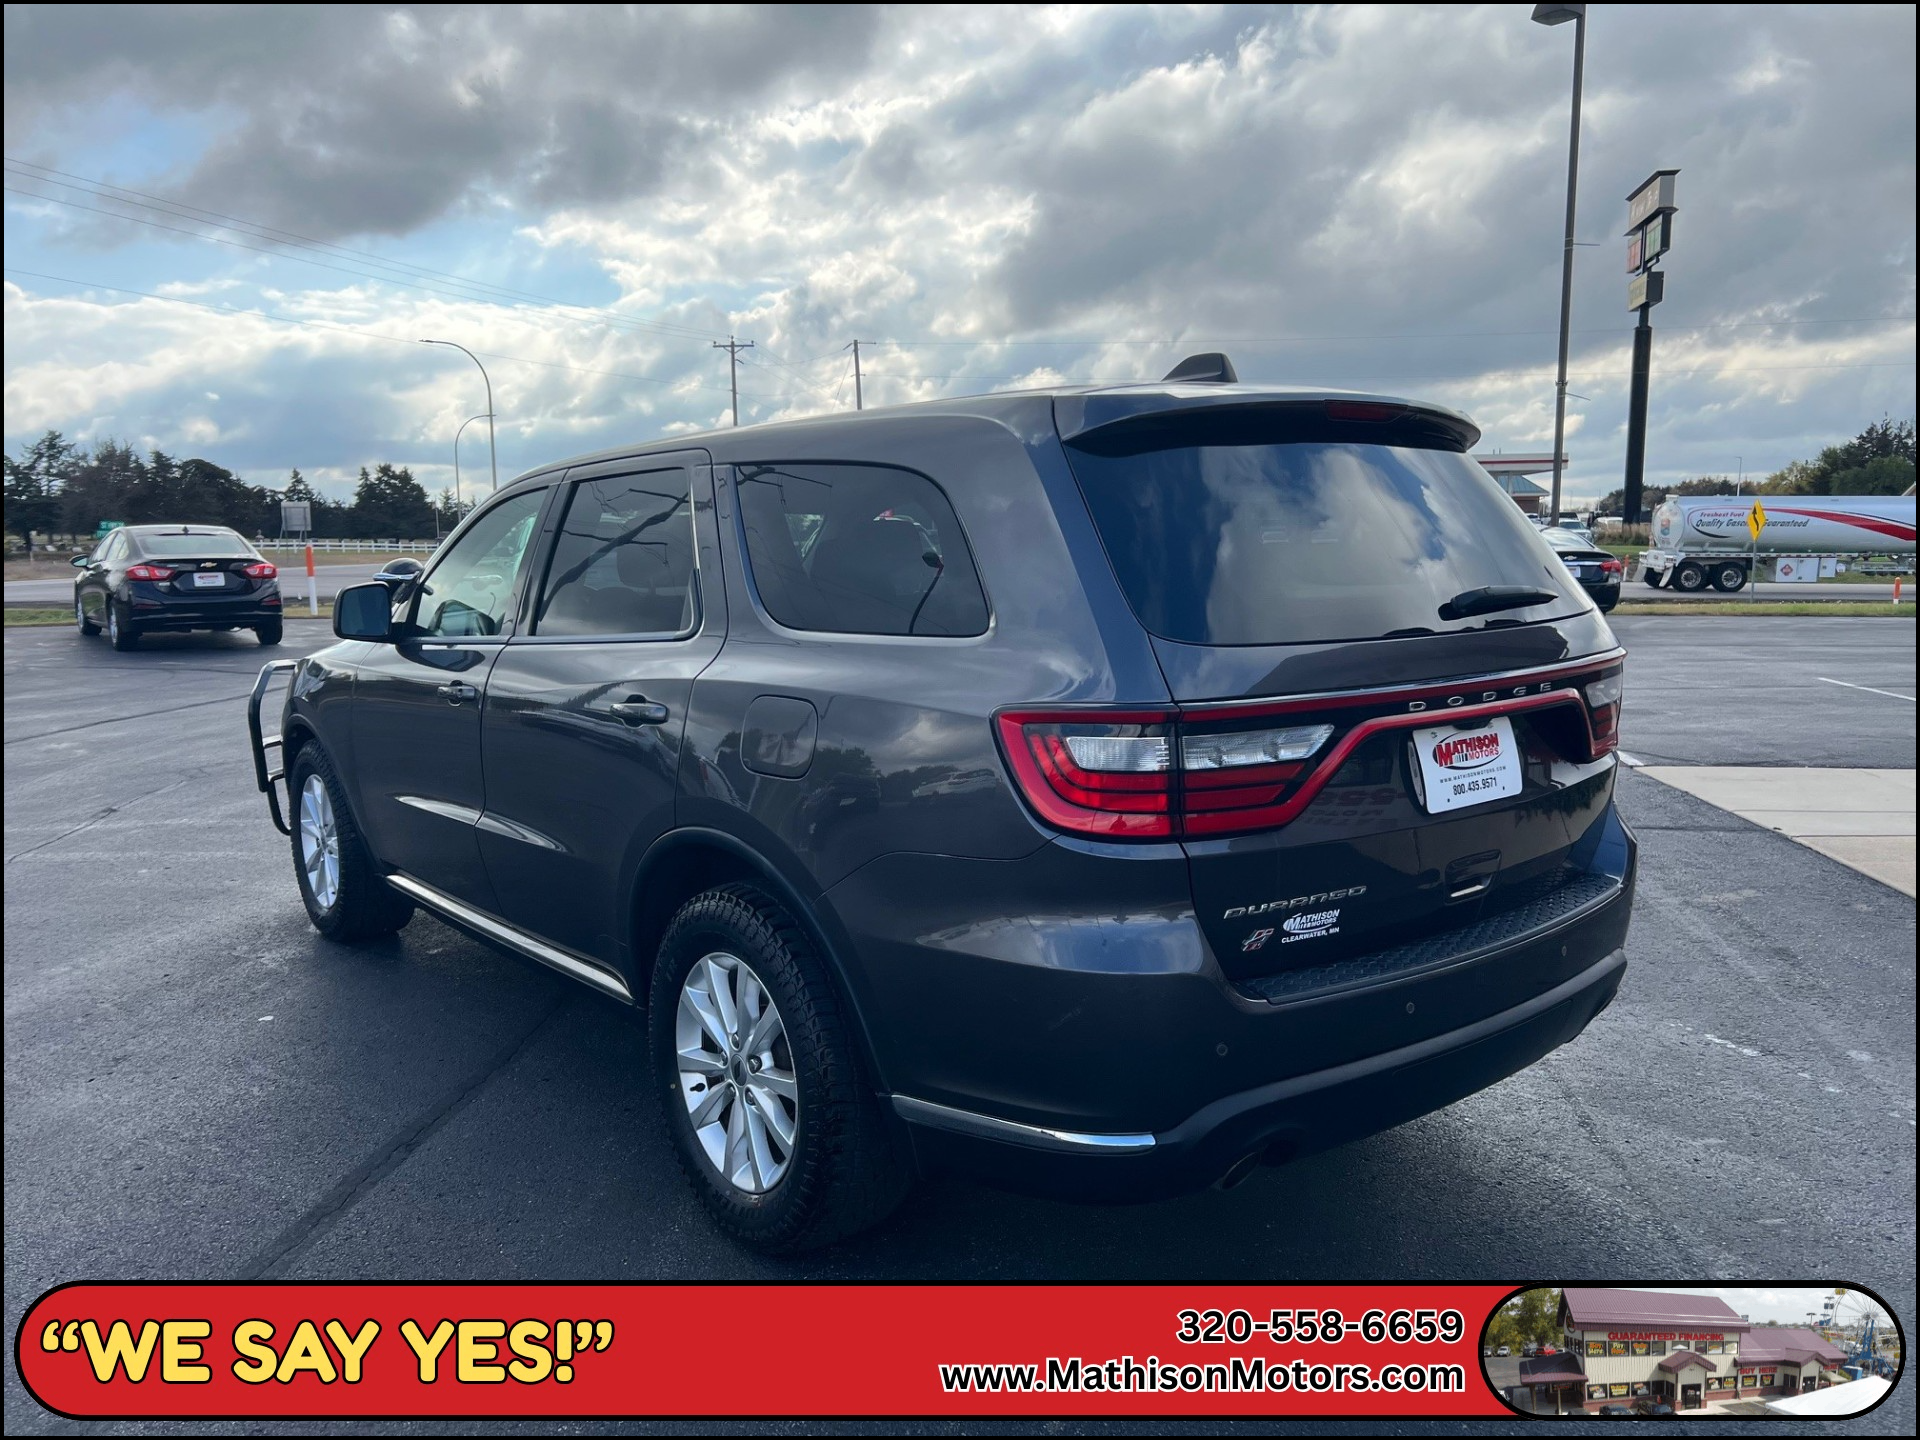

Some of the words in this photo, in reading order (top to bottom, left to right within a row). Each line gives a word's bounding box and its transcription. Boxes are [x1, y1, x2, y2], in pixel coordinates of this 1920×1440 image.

[1695, 518, 1725, 529] Quality
[1408, 682, 1552, 712] DODGE
[1436, 732, 1499, 767] MATHISON
[1468, 747, 1499, 761] MOTORS
[1452, 776, 1498, 796] 800.435.9571
[1223, 885, 1368, 920] DURANGO
[1286, 908, 1340, 931] MATHISON
[1311, 917, 1337, 927] MOTORS
[1281, 930, 1328, 944] CLEARWATER,
[1329, 926, 1340, 934] MN
[1607, 1331, 1677, 1341] GUARANTEED
[1678, 1332, 1725, 1341] FINANCING
[1740, 1367, 1756, 1375] BUY
